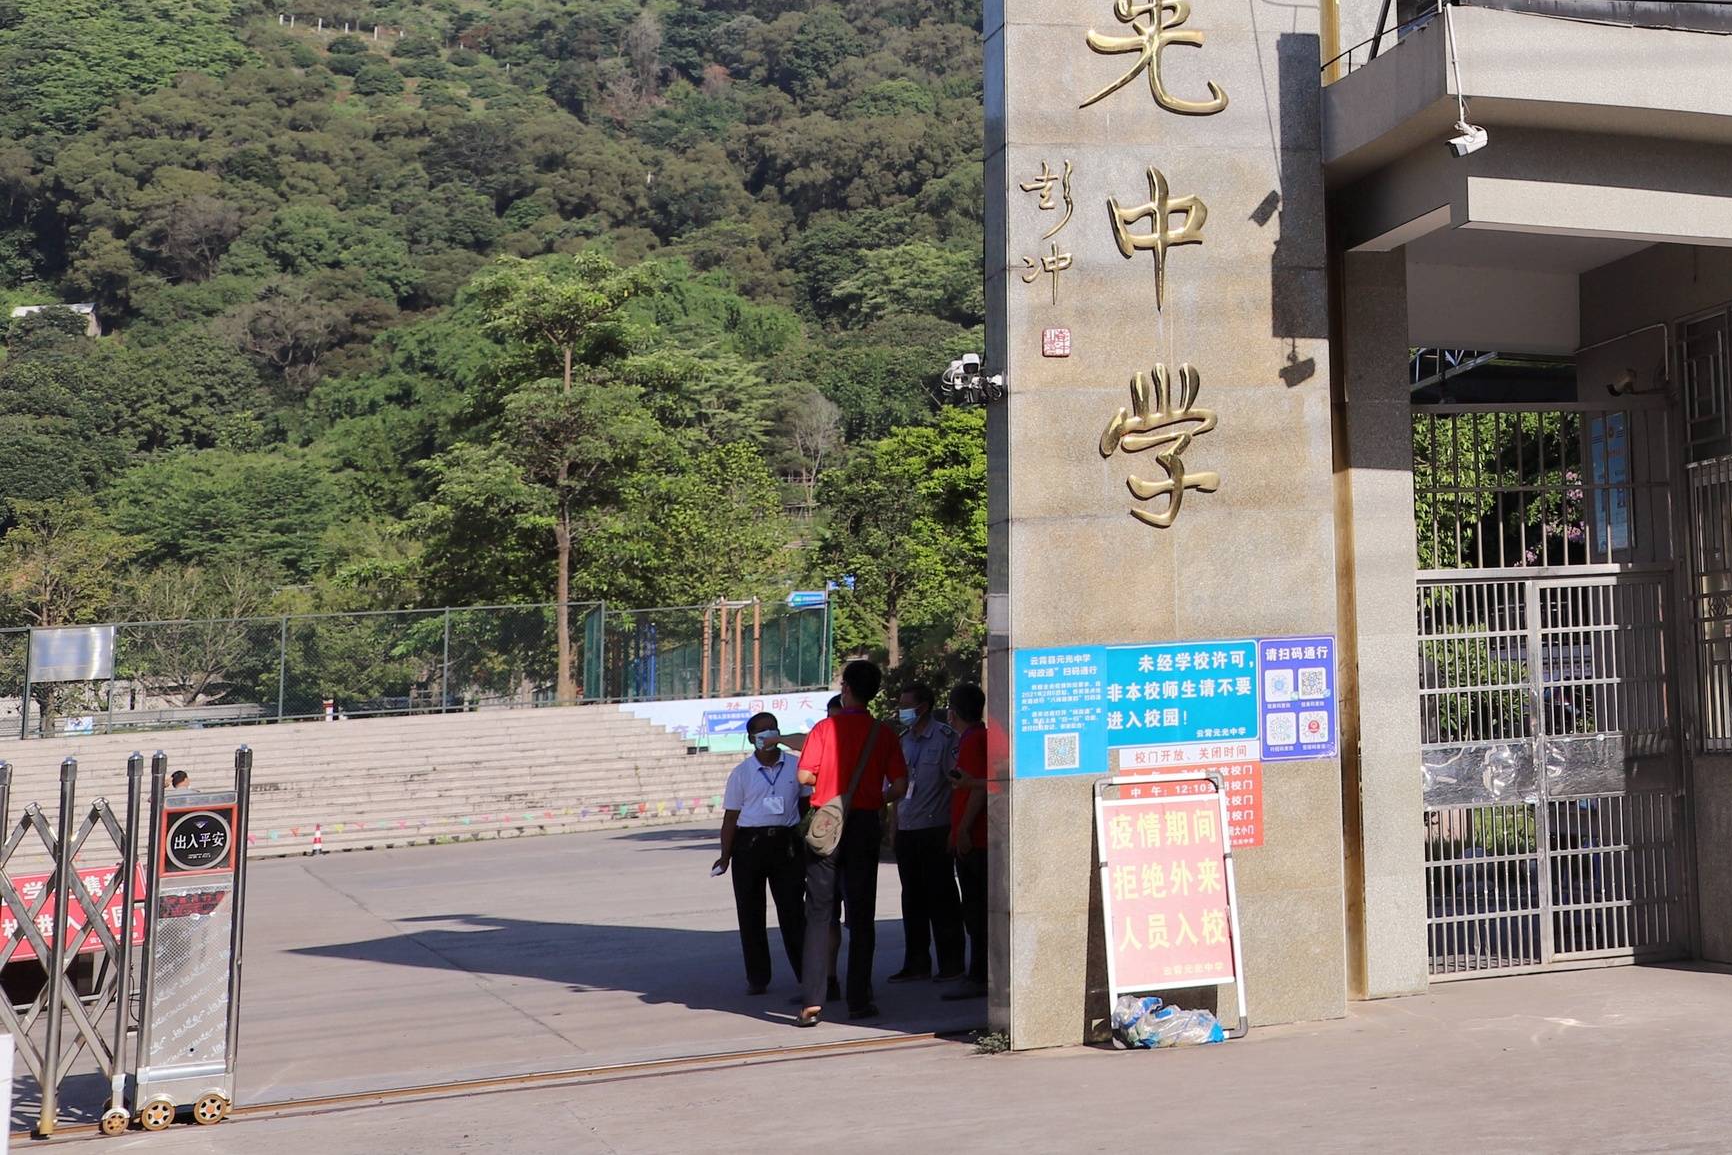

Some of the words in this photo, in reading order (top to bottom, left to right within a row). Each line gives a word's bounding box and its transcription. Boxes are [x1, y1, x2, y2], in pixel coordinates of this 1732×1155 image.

[1265, 646, 1329, 661] 请扫码通行
[1107, 677, 1252, 703] 非本校师生请不要
[1135, 744, 1248, 764] 校门开放、关闭时间
[174, 831, 225, 850] 出入平安
[1108, 809, 1218, 850] 疫情期间
[1113, 857, 1222, 901] 拒绝外来
[1119, 907, 1227, 953] 人员入校
